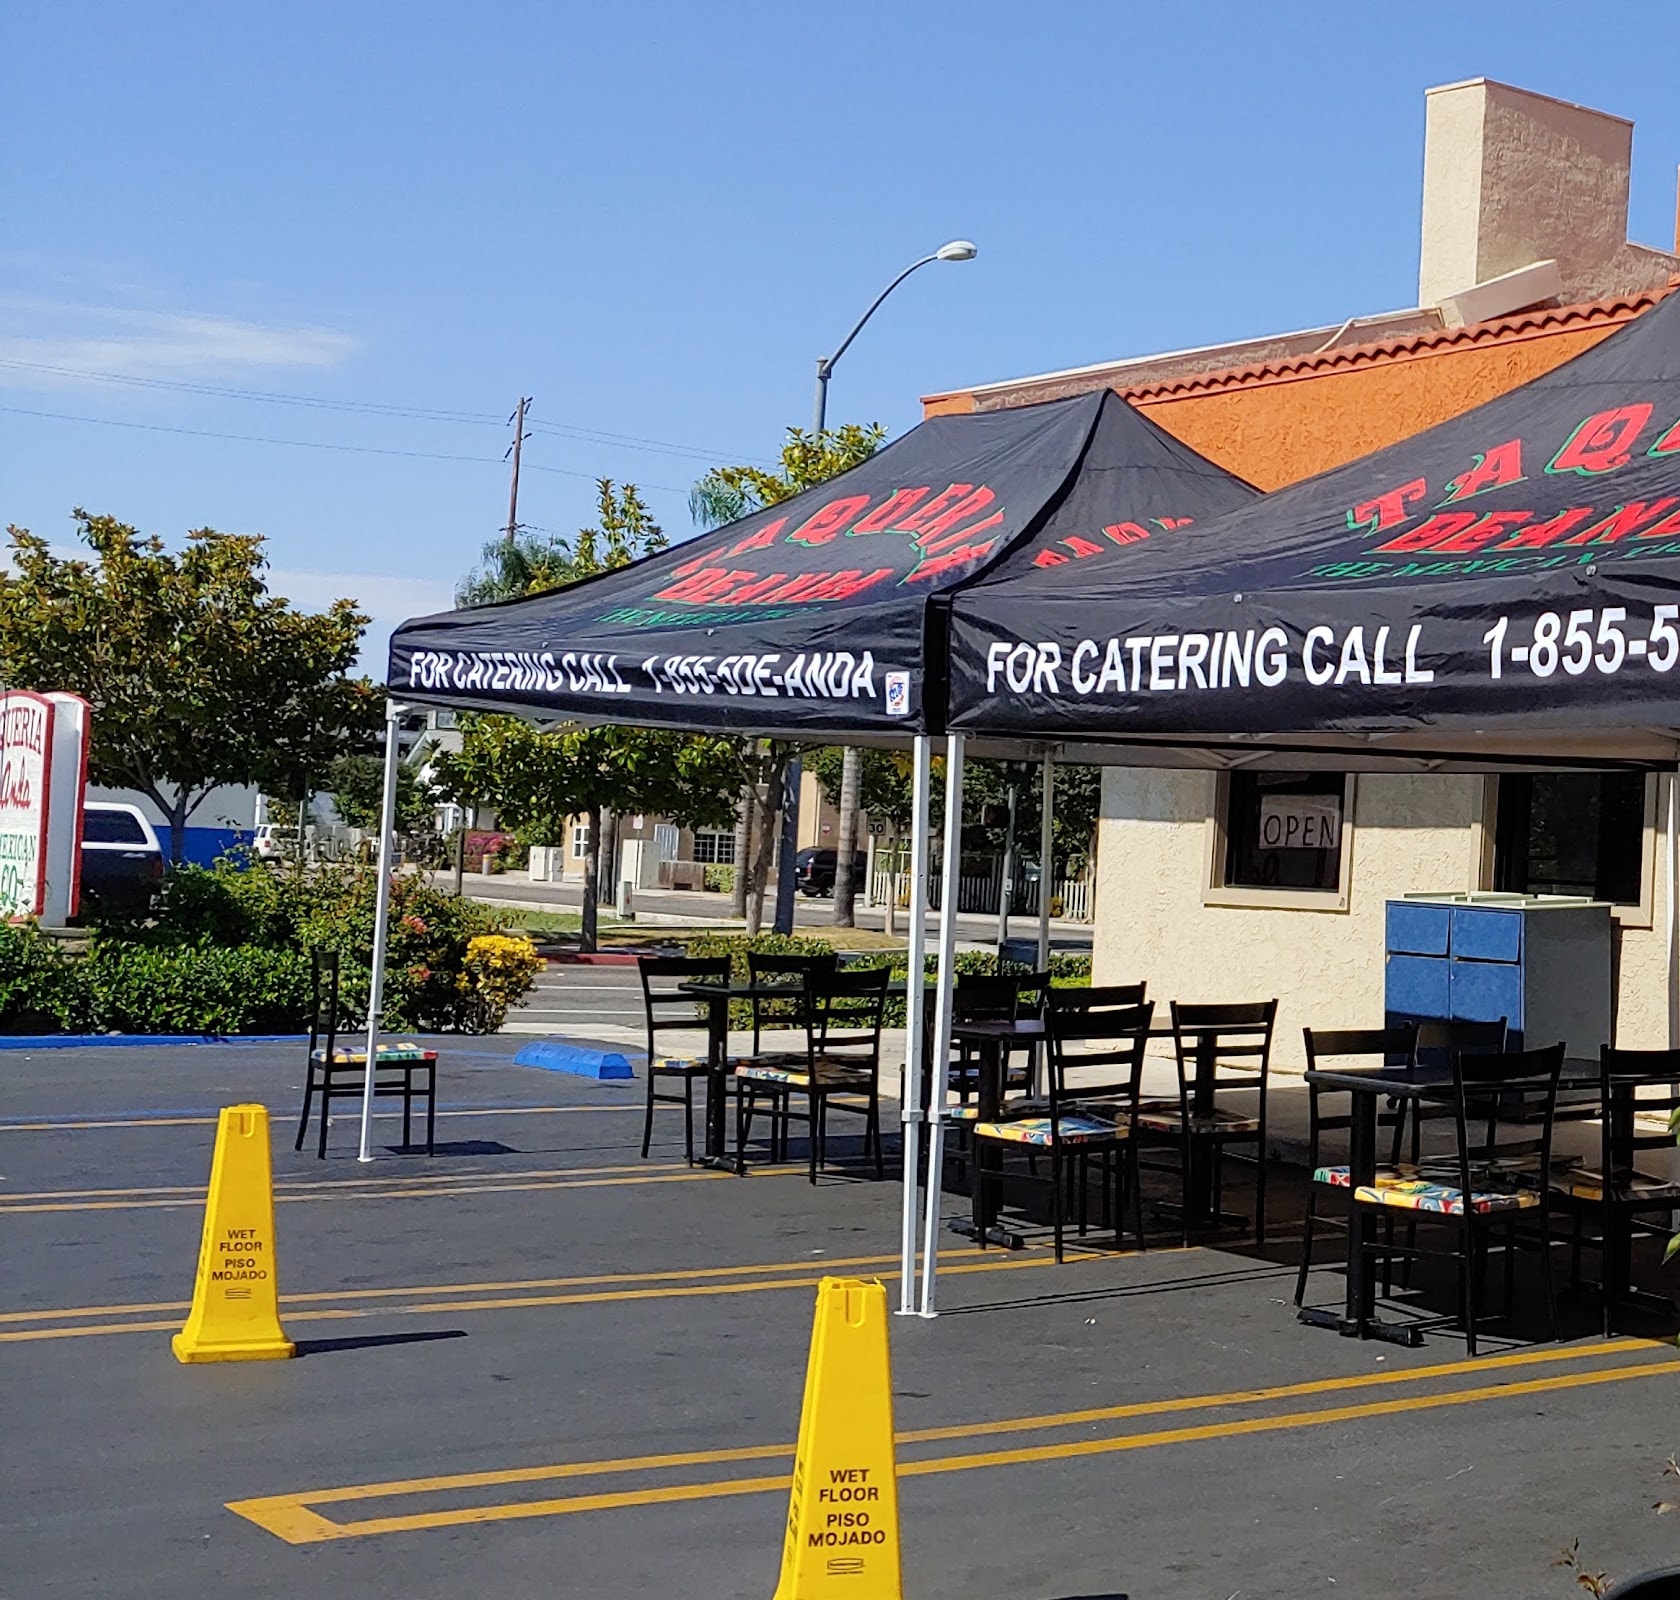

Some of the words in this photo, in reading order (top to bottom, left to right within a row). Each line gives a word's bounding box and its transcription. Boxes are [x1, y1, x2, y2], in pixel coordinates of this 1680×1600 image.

[664, 483, 1004, 587] TAQUERIA
[986, 641, 1062, 694] FOR
[1070, 627, 1289, 694] CATERING
[1303, 624, 1436, 686] CALL
[408, 651, 453, 690] FOR
[453, 651, 563, 692] CATERING
[561, 654, 633, 694] CALL
[642, 650, 877, 699] 1-855-5DE-ANDA
[0, 706, 42, 755] UERIA
[1264, 815, 1335, 846] OPEN
[0, 834, 37, 862] EXICAN
[228, 1229, 256, 1239] WET
[219, 1242, 262, 1252] FLOOR
[225, 1258, 256, 1269] PISO
[211, 1270, 267, 1281] MOJADO
[830, 1469, 870, 1484] WET
[819, 1487, 879, 1503] FLOOR
[827, 1512, 870, 1528] PISO
[808, 1530, 886, 1547] MOJADO
